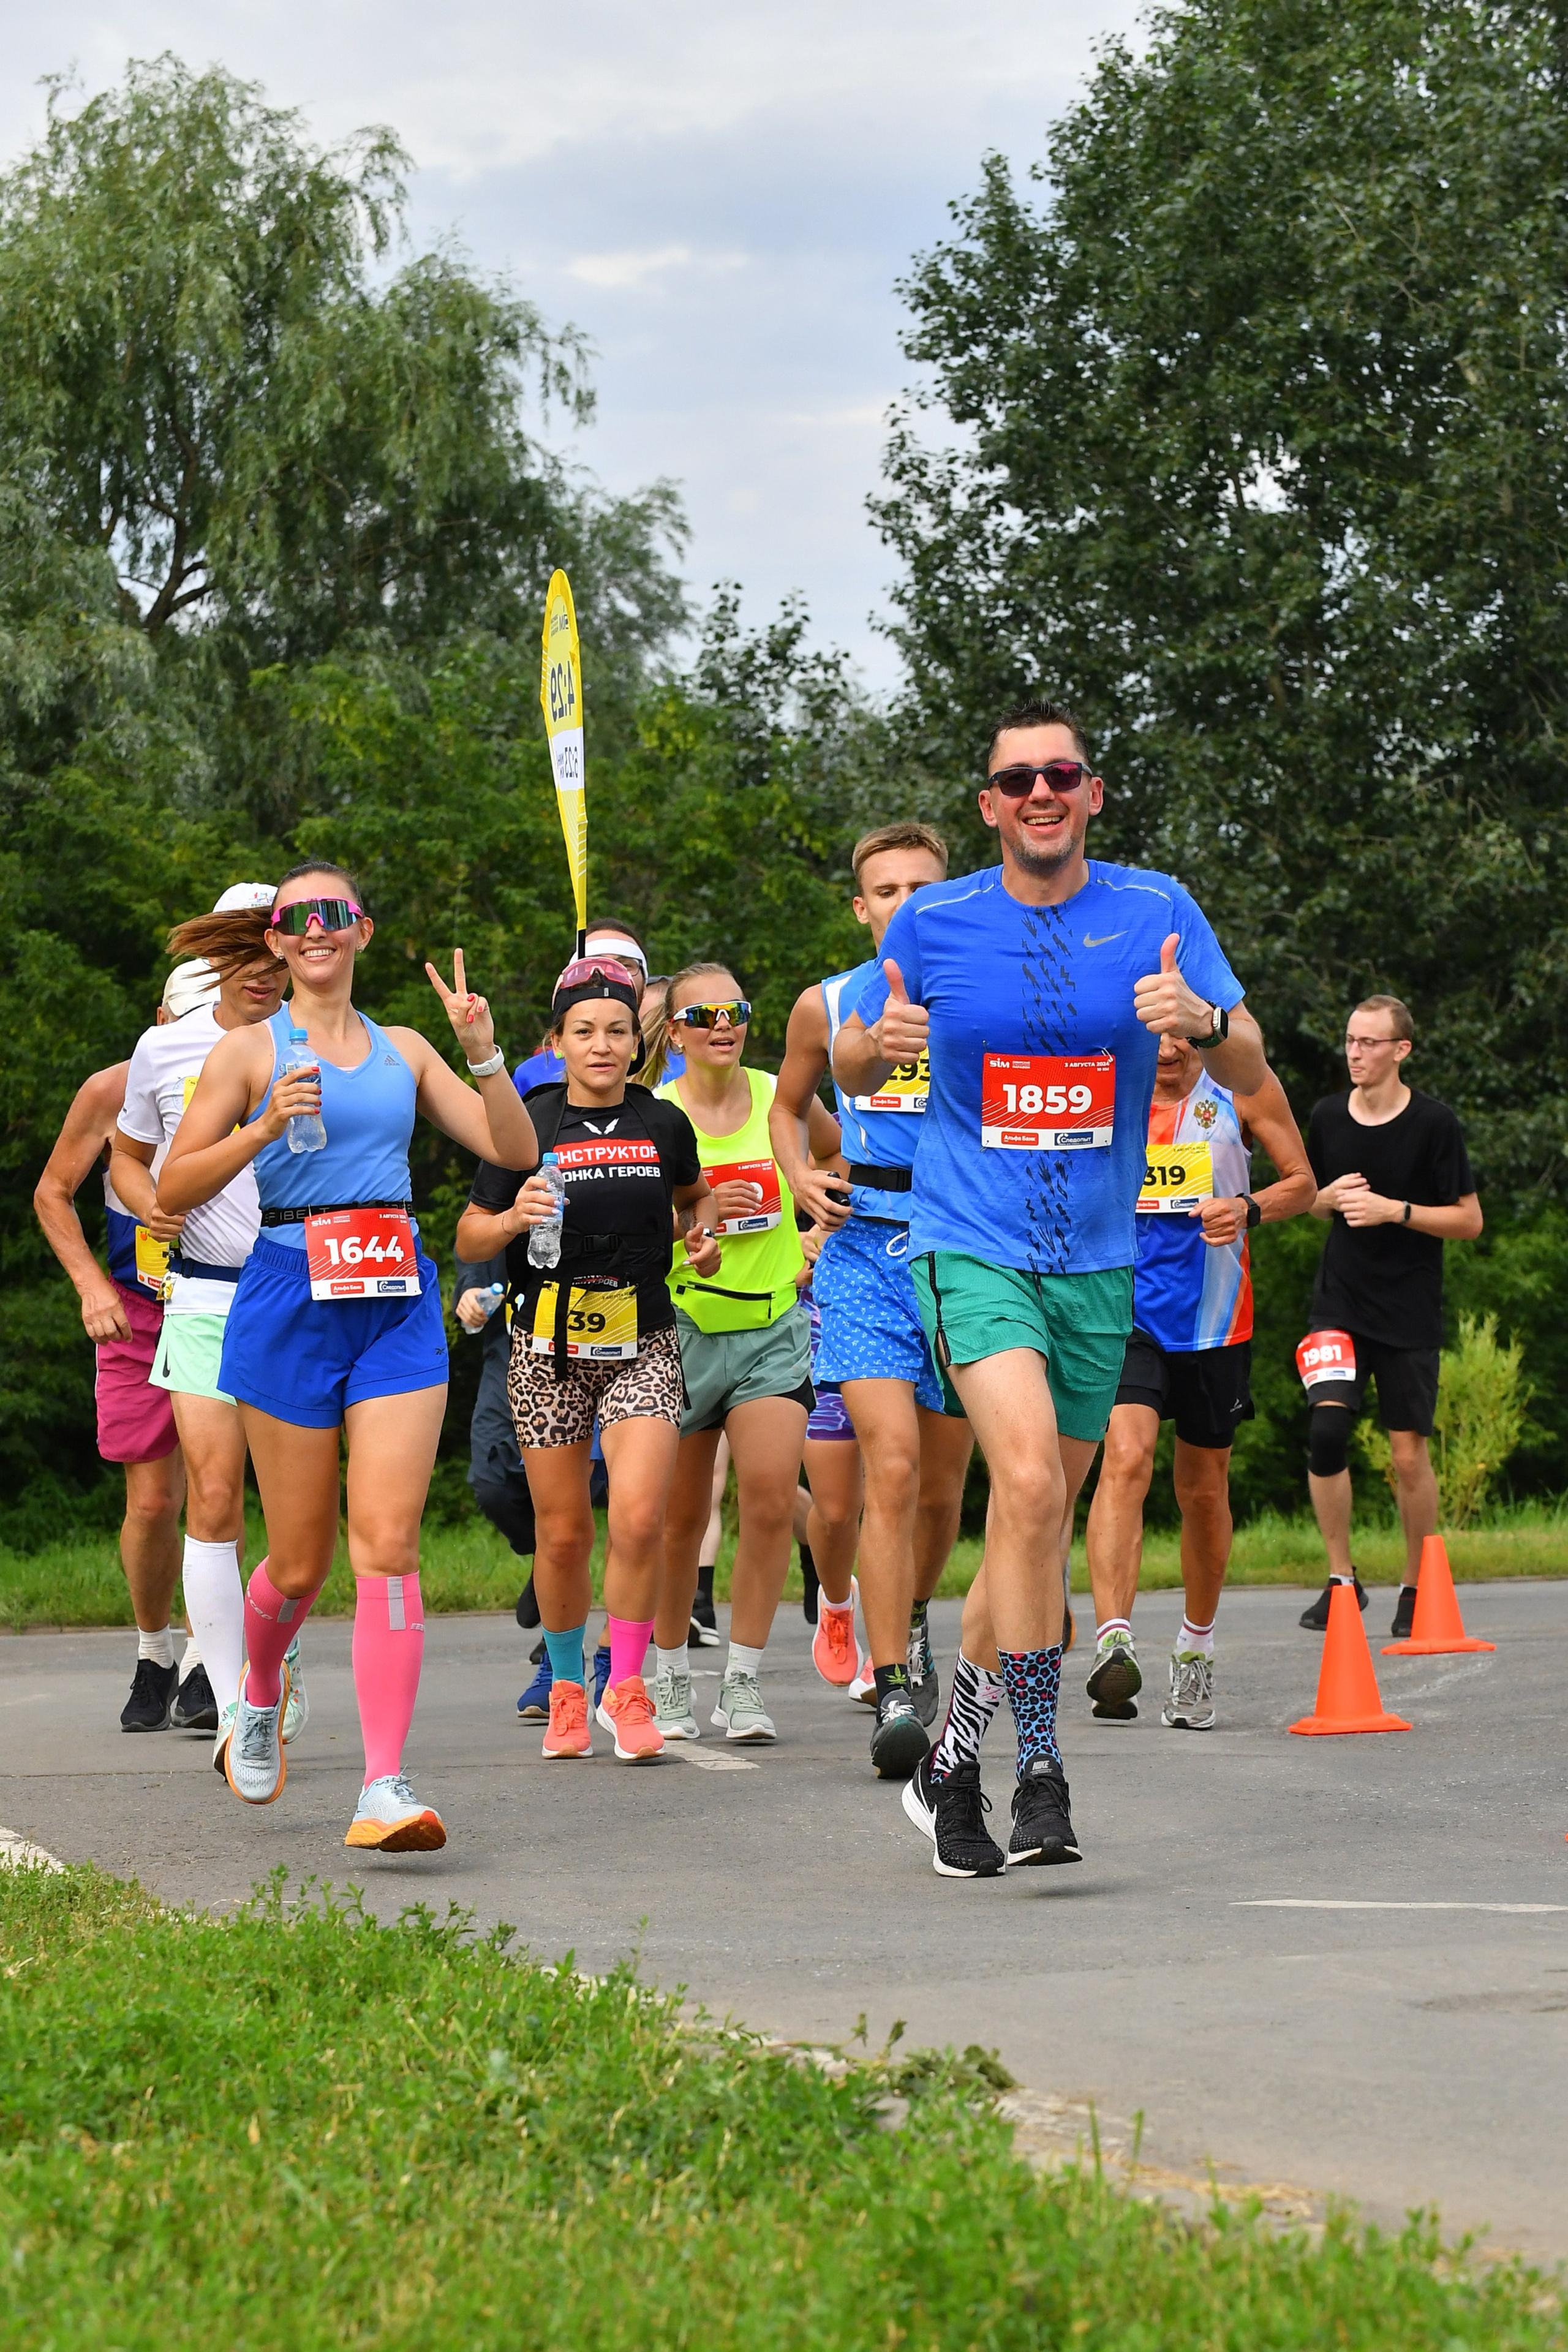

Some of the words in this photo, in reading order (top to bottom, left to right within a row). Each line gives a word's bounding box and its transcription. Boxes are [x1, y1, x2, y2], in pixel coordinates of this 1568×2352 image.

[1002, 1084, 1093, 1114] 1859
[562, 1167, 605, 1183] ОНКА
[608, 1166, 661, 1178] ГЕРОЕВ
[1144, 1165, 1186, 1186] 319
[324, 1235, 404, 1265] 1644
[1302, 1344, 1342, 1368] 1981
